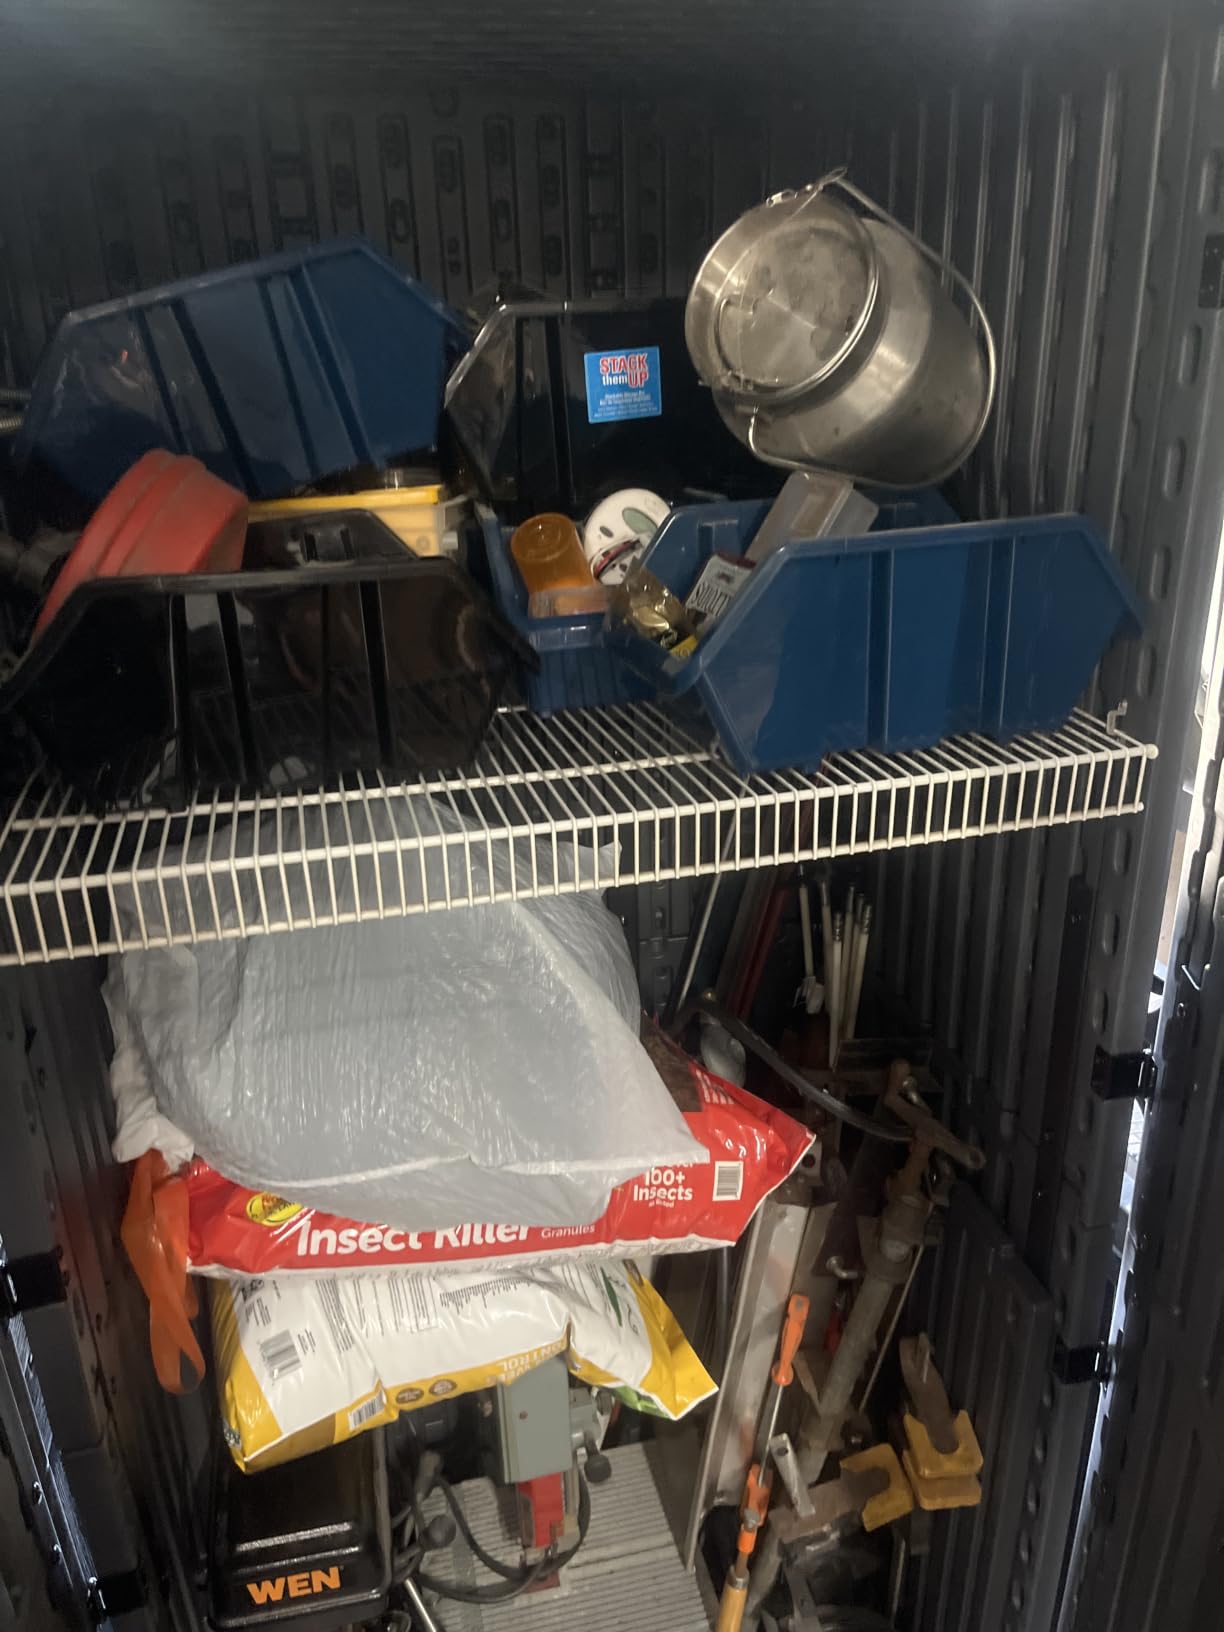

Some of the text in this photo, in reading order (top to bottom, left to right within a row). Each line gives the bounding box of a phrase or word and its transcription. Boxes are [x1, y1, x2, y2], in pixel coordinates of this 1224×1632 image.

[600, 353, 648, 375] STACK
[602, 368, 648, 388] them UP
[645, 1169, 686, 1186] 100+
[633, 1184, 693, 1201] Insects
[297, 1219, 596, 1257] Insect Killer Granules
[246, 1566, 341, 1605] WEN
